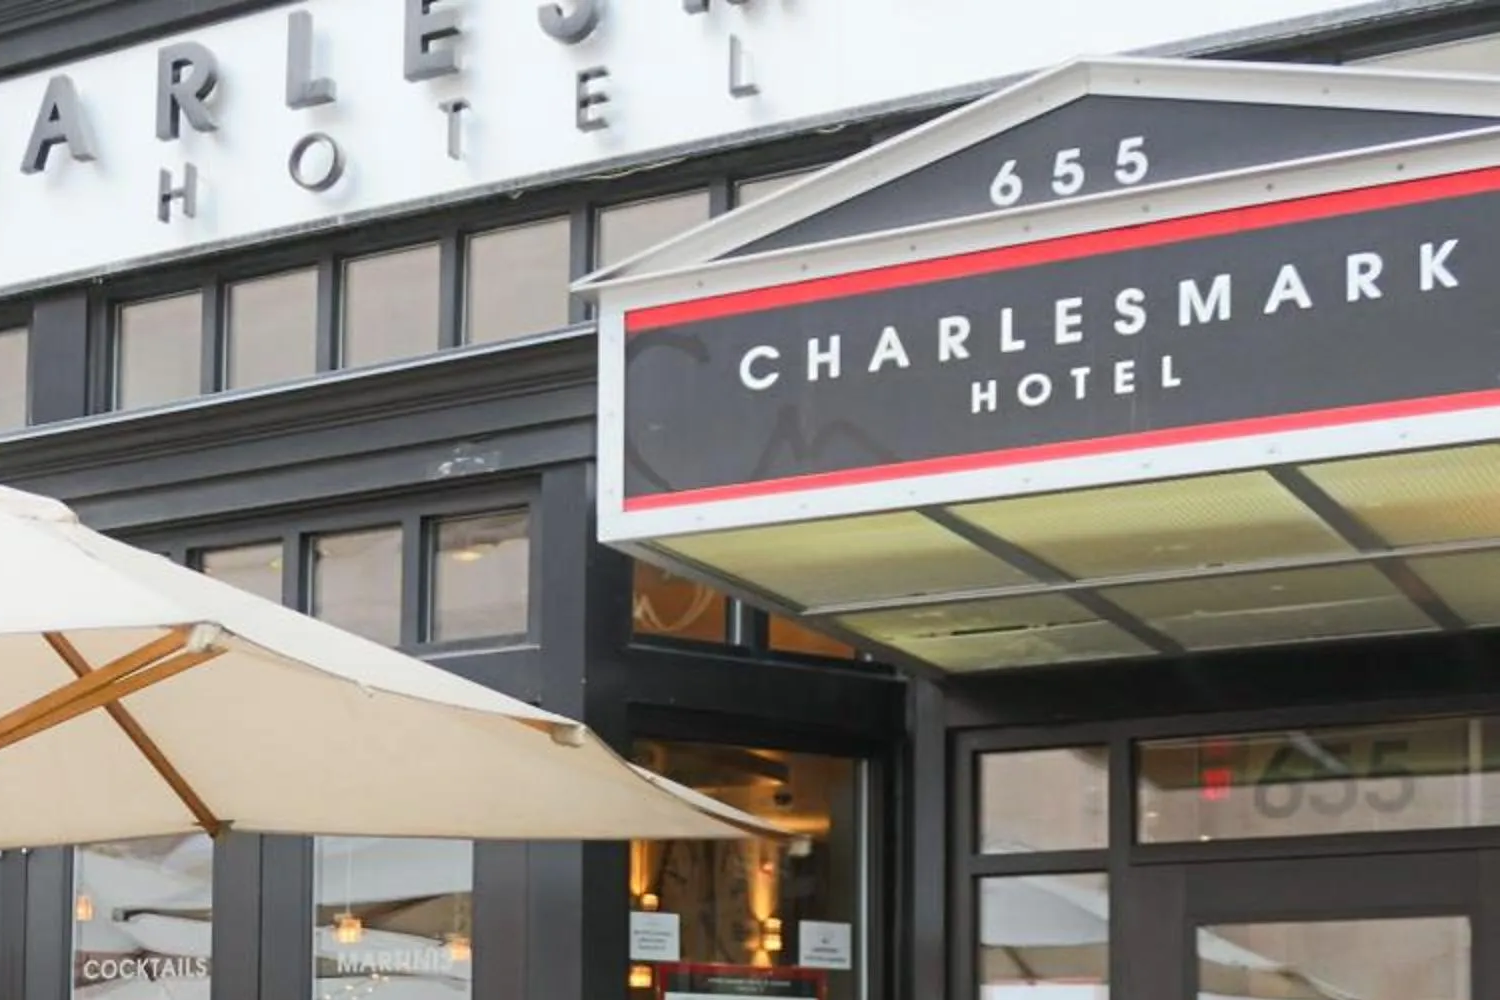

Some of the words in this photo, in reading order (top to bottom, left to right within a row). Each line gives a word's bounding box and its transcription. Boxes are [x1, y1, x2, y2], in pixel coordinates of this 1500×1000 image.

[156, 34, 761, 224] HOTEL
[988, 136, 1150, 208] 655
[738, 237, 1461, 391] CHARLESMARK
[970, 354, 1183, 415] HOTEL
[1253, 738, 1416, 820] 655
[82, 955, 210, 981] COCKTAILS
[336, 947, 455, 974] MARTINIS
